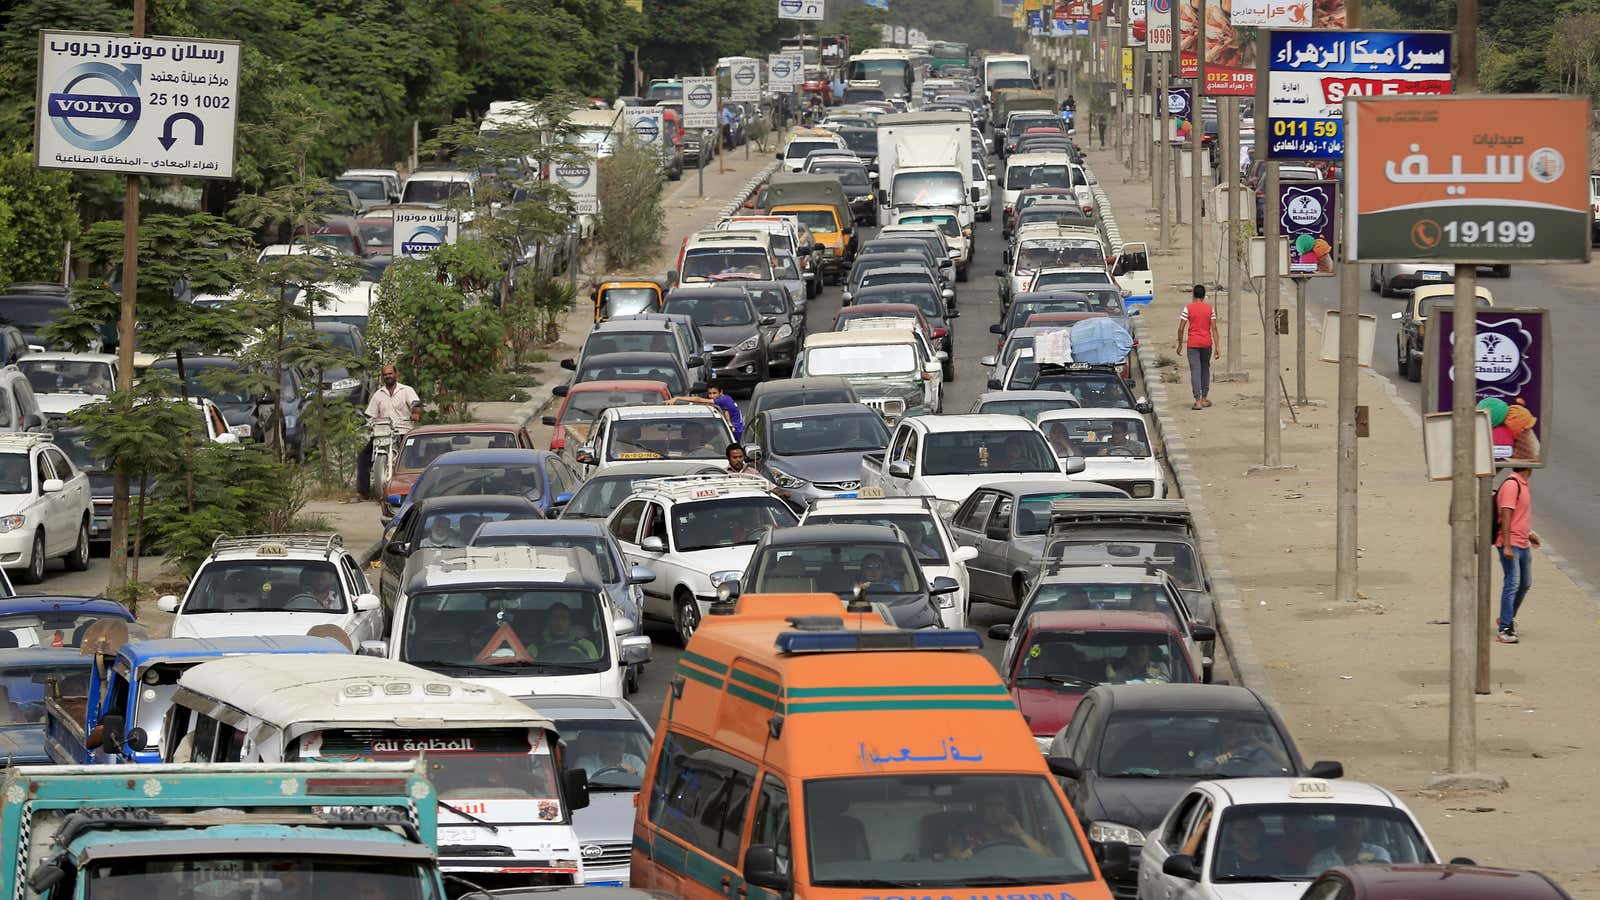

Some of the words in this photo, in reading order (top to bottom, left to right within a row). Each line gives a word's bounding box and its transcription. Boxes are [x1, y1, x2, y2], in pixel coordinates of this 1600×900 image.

[1149, 29, 1170, 44] 1996
[50, 40, 100, 58] جروب
[104, 40, 166, 60] موتورز
[172, 44, 225, 64] رسلان
[1276, 40, 1346, 68] الزهراء
[1350, 40, 1445, 70] سيراميكا
[1181, 58, 1198, 66] 012
[150, 72, 180, 84] معتمد
[180, 72, 206, 85] صيانة
[208, 73, 229, 86] مركز
[1207, 73, 1228, 81] 012
[56, 99, 134, 114] VOLVO
[150, 93, 167, 106] 25
[171, 93, 189, 107] 19
[194, 96, 230, 109] 1002
[1274, 120, 1308, 136] 011
[1314, 121, 1337, 137] 59
[1472, 133, 1524, 147] صيدليات
[55, 152, 98, 164] الصناعية
[100, 153, 141, 166] المنطقة
[151, 158, 190, 171] المعادى
[192, 158, 218, 171] زهراء
[1385, 144, 1524, 195] سيف
[1444, 221, 1535, 243] 19199
[1475, 354, 1512, 365] خليف
[1299, 783, 1327, 793] TAXI
